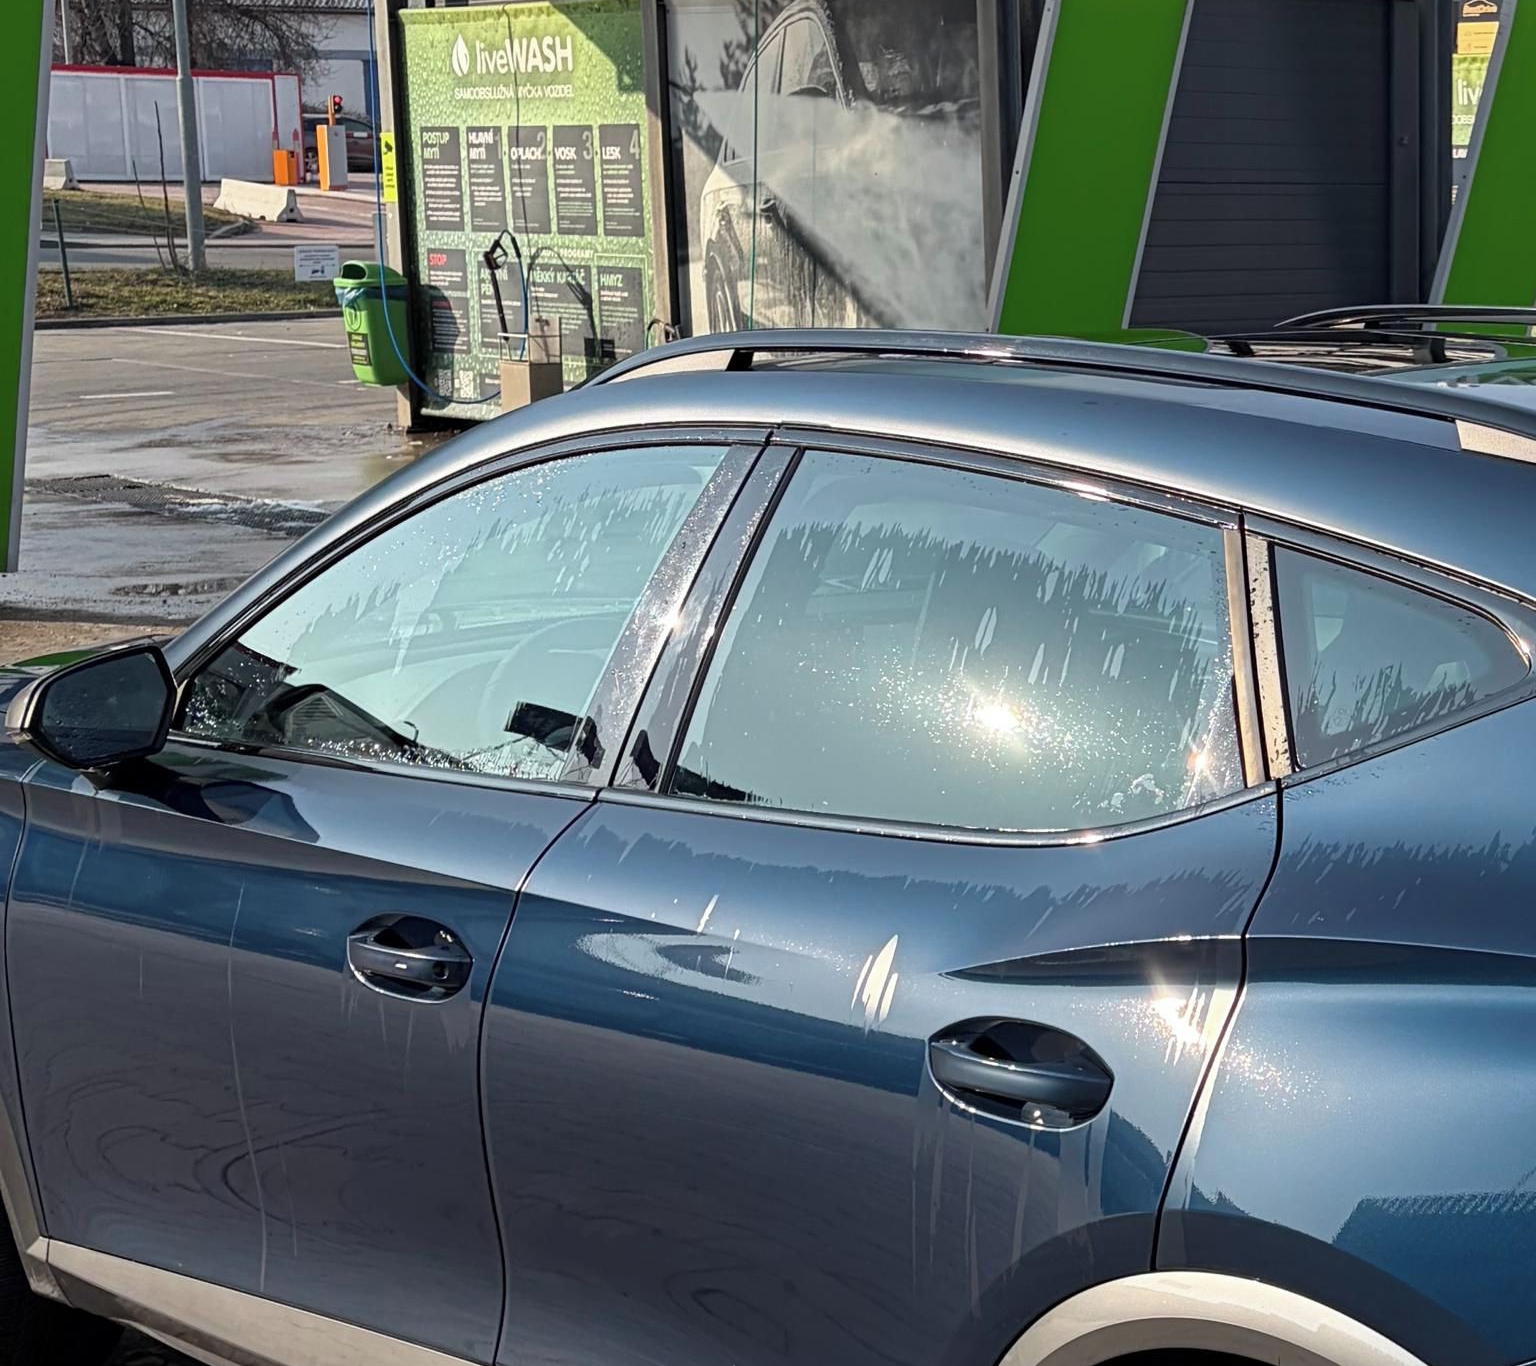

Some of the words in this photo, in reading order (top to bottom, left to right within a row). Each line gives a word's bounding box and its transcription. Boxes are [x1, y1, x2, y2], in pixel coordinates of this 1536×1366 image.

[475, 35, 574, 75] liveWASH
[544, 84, 575, 98] VOZIDEL
[422, 131, 450, 144] POSTUP
[468, 128, 494, 144] HLAVNÍ
[582, 130, 593, 160] 3
[629, 129, 640, 160] 4
[554, 147, 577, 160] VOSK
[602, 146, 621, 160] LESK
[428, 253, 447, 266] STOP
[599, 273, 623, 287] HMYZ
